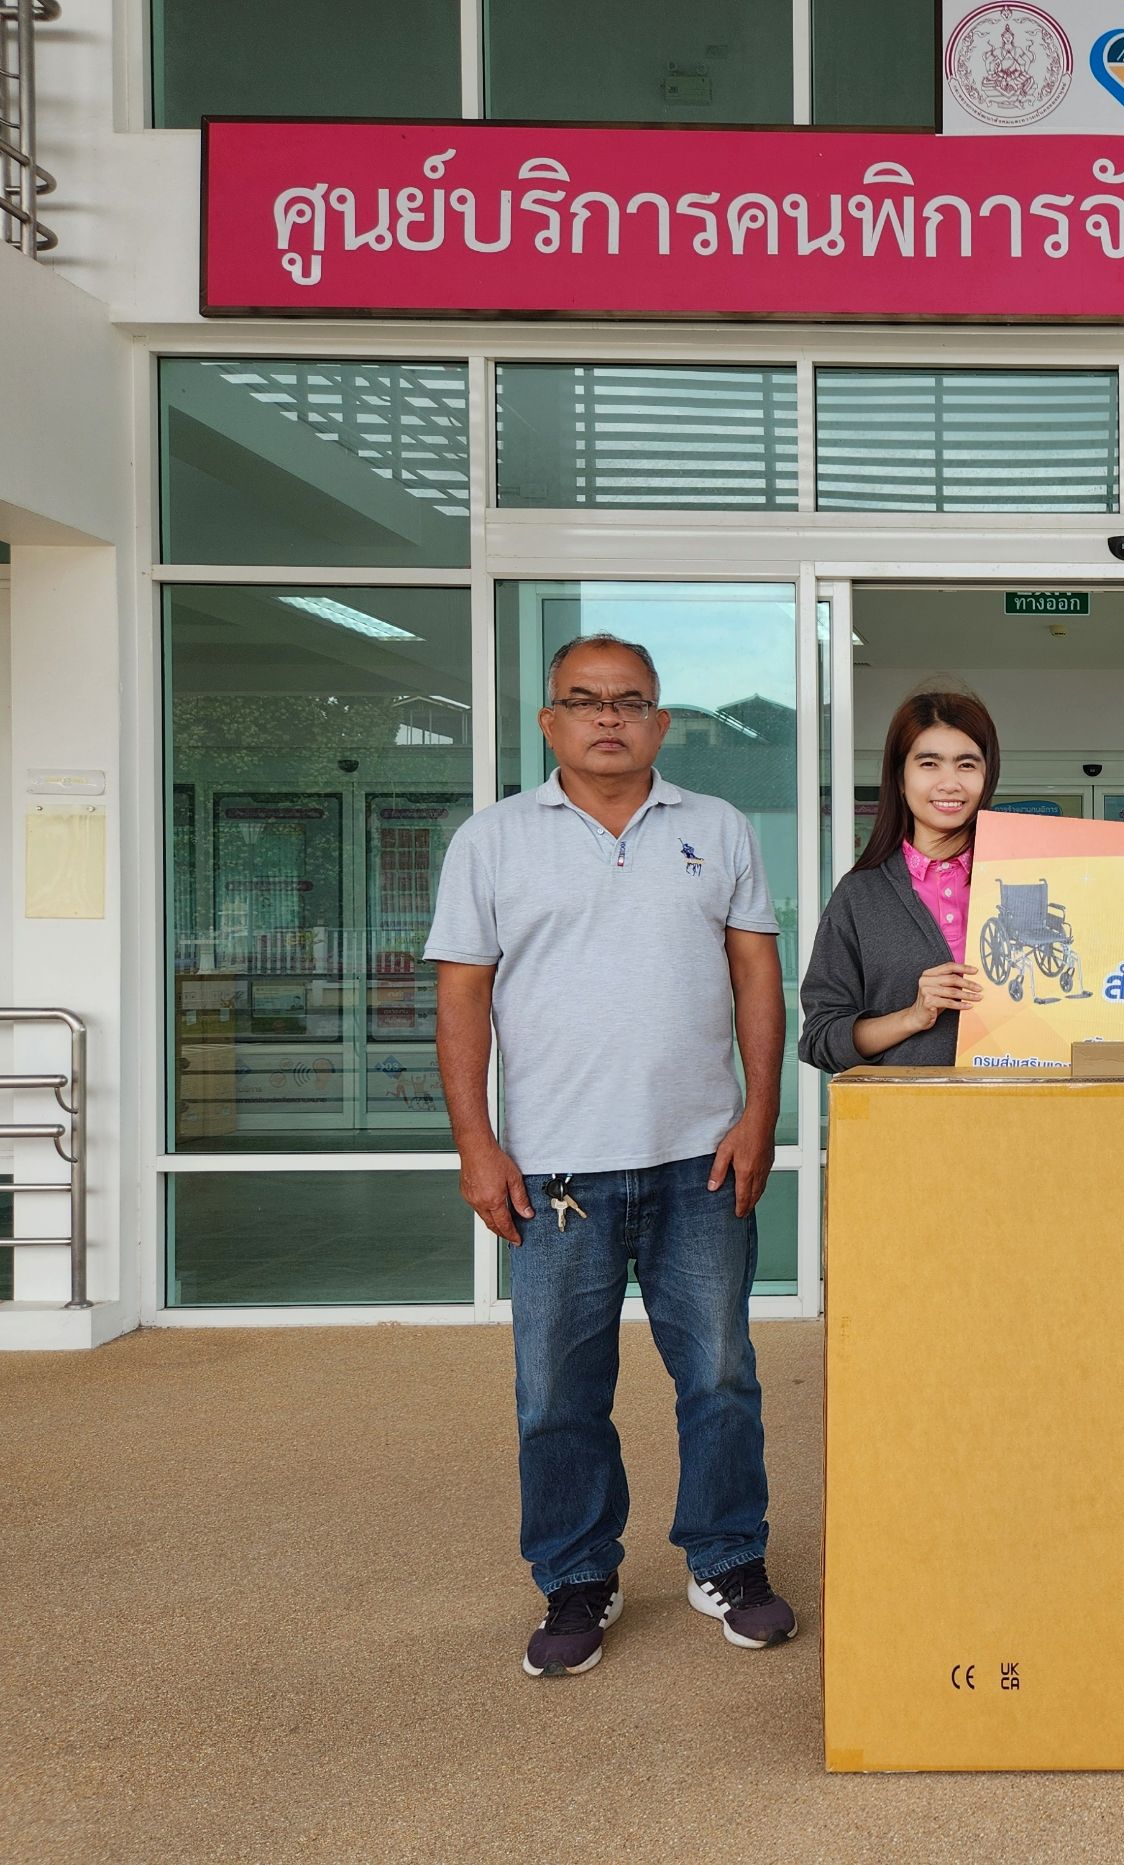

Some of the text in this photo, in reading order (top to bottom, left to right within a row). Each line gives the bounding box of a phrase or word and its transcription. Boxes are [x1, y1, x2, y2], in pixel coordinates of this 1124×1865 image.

[1014, 597, 1081, 611] ทางออก
[1000, 1662, 1020, 1676] UK
[951, 1664, 975, 1690] CE
[1000, 1676, 1020, 1690] CA
